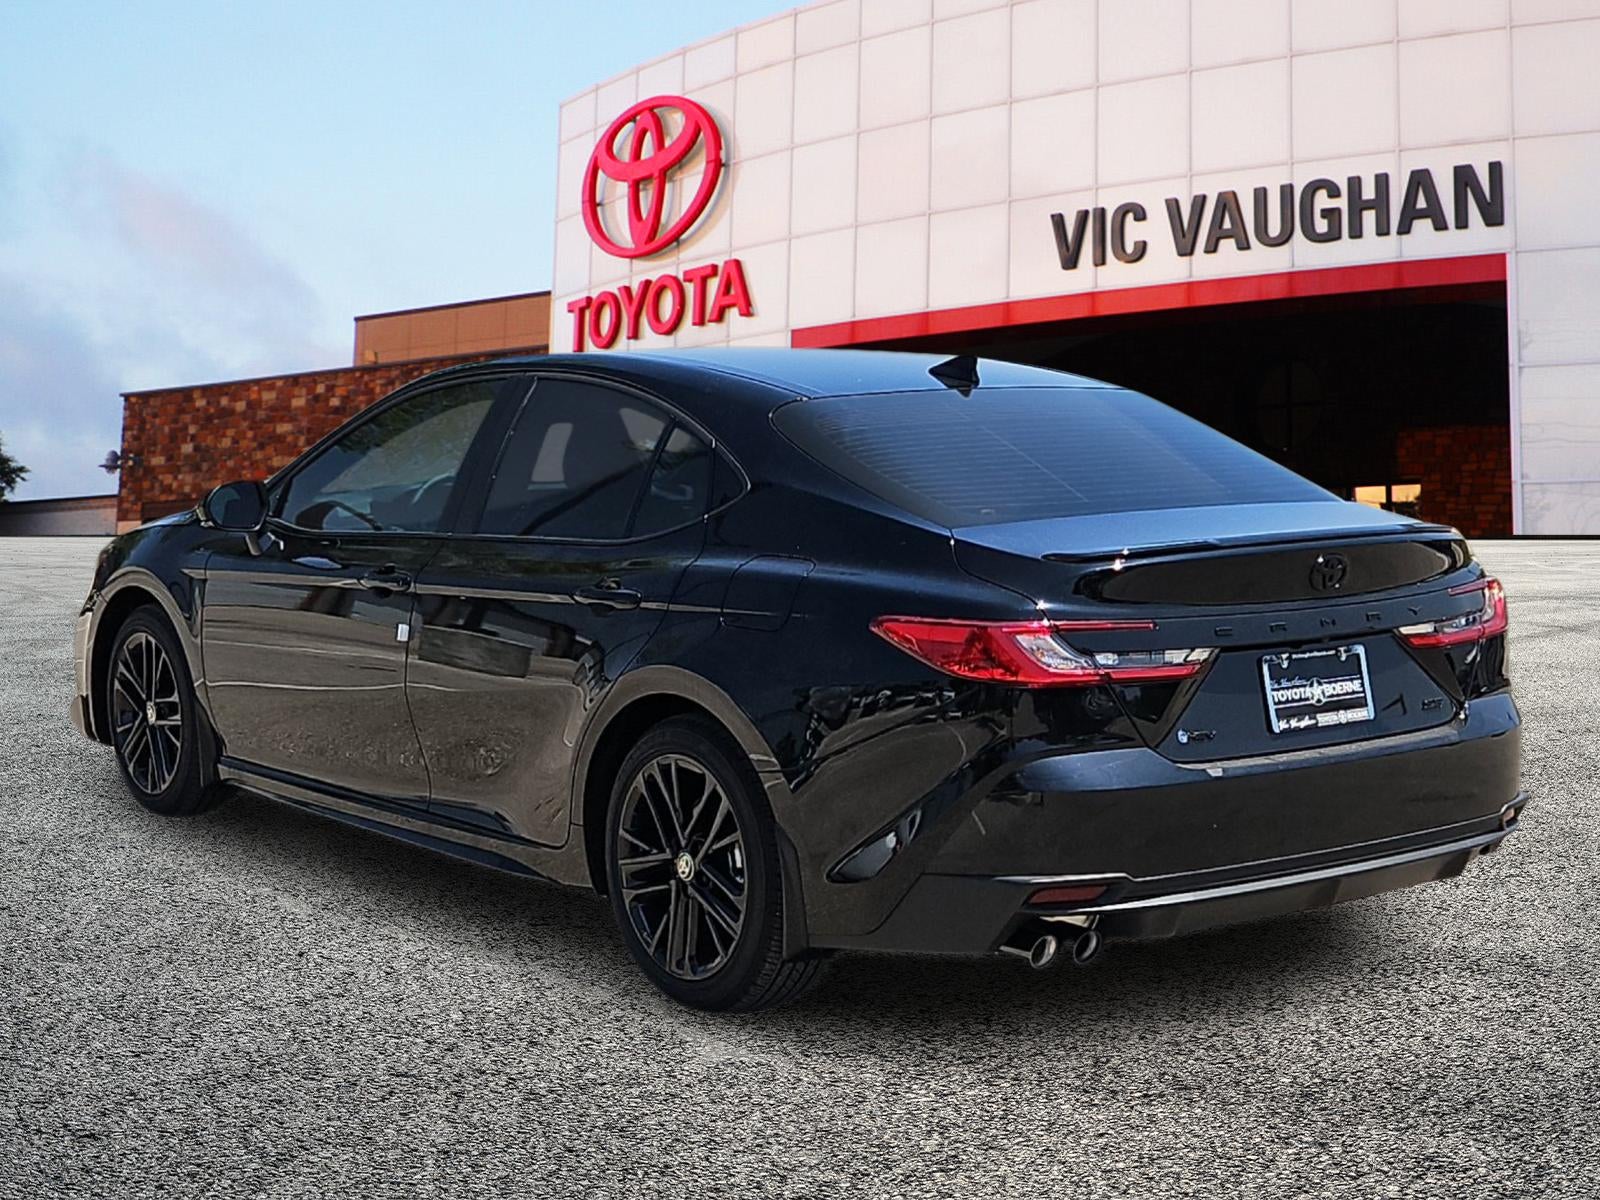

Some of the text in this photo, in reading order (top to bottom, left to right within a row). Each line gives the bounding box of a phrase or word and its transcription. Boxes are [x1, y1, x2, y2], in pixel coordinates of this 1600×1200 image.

[1050, 160, 1505, 271] VIC VAUGHAN
[567, 258, 754, 353] TOYOTA
[1271, 680, 1364, 703] TOYOTA BOERNE
